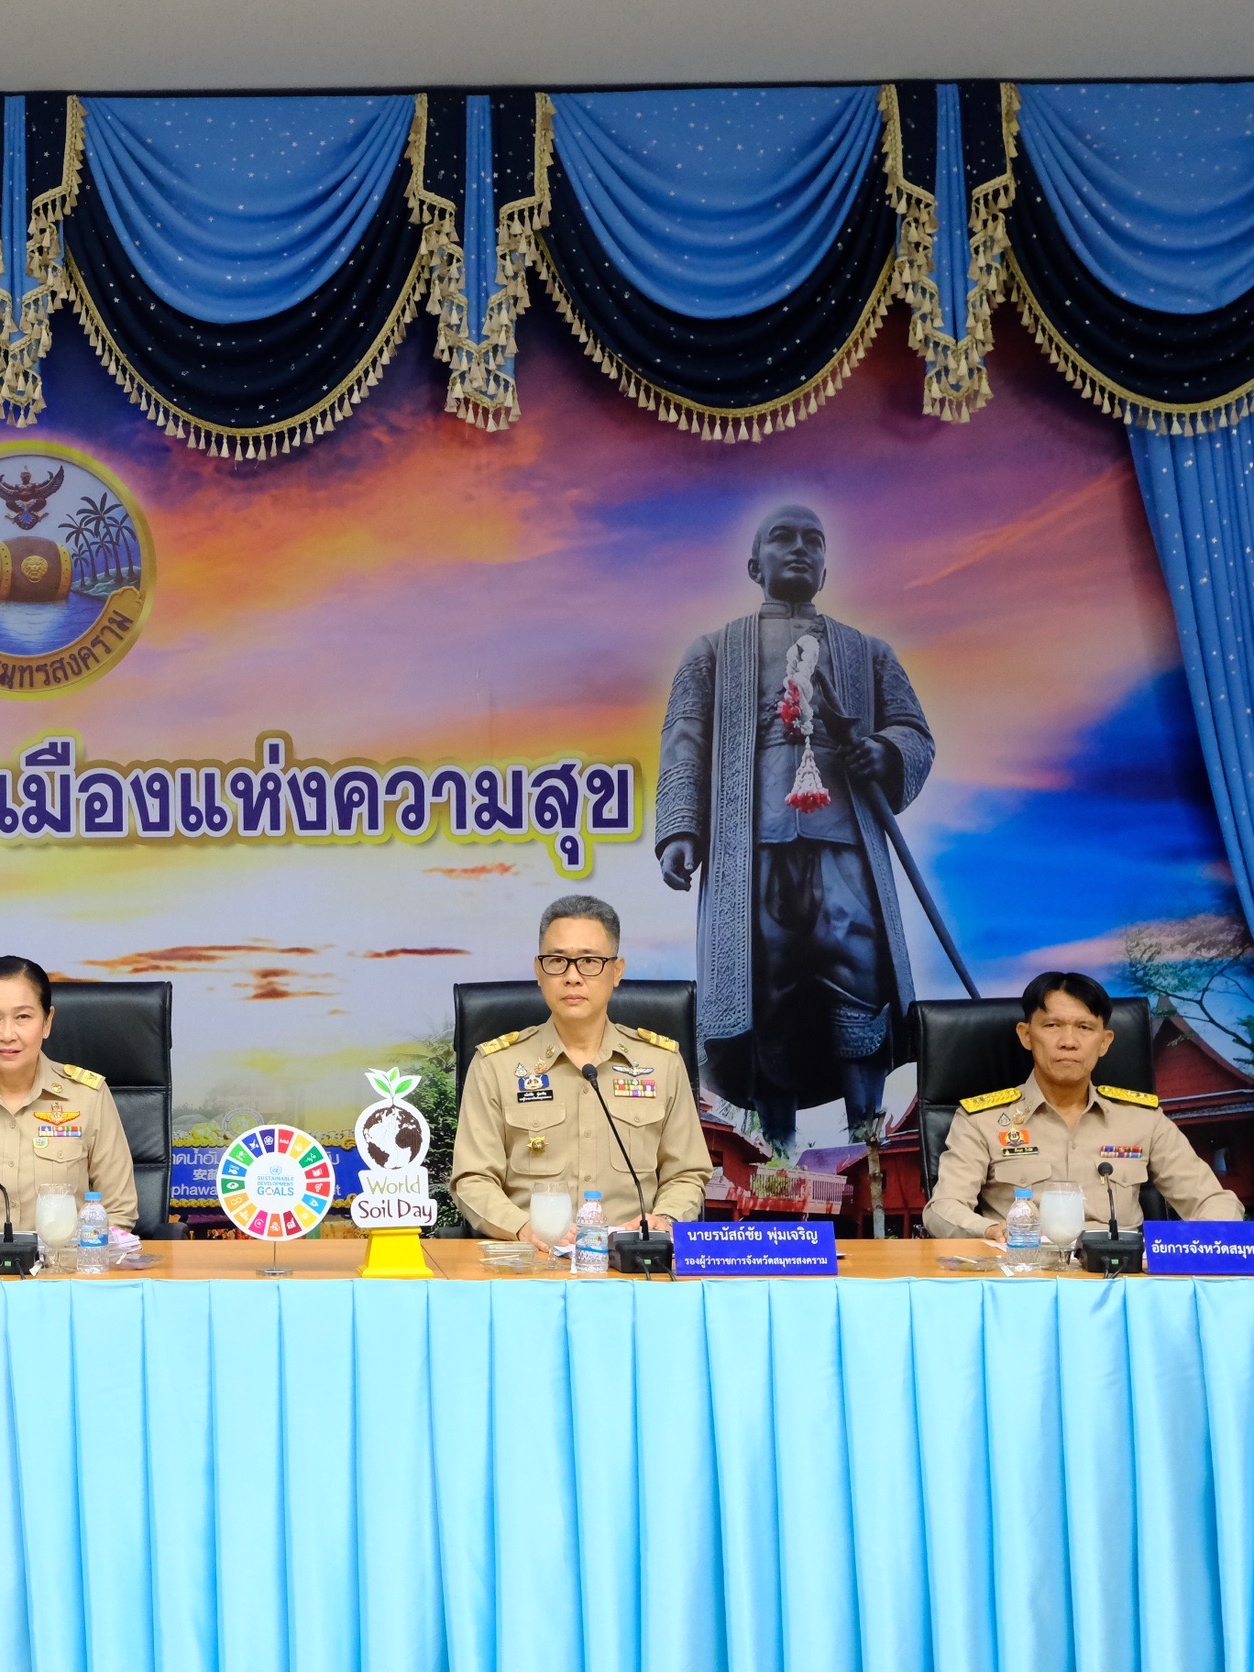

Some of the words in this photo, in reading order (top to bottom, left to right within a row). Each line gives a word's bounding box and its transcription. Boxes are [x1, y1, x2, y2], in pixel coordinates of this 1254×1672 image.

[257, 1186, 294, 1196] GOALS
[366, 1174, 421, 1195] World
[358, 1199, 393, 1219] Soil
[398, 1199, 432, 1223] Day
[766, 1227, 819, 1245] พุ่มเจริญ
[684, 1255, 828, 1268] รองผู้ว่าราชการจังหวัดสมุทรสงคราม
